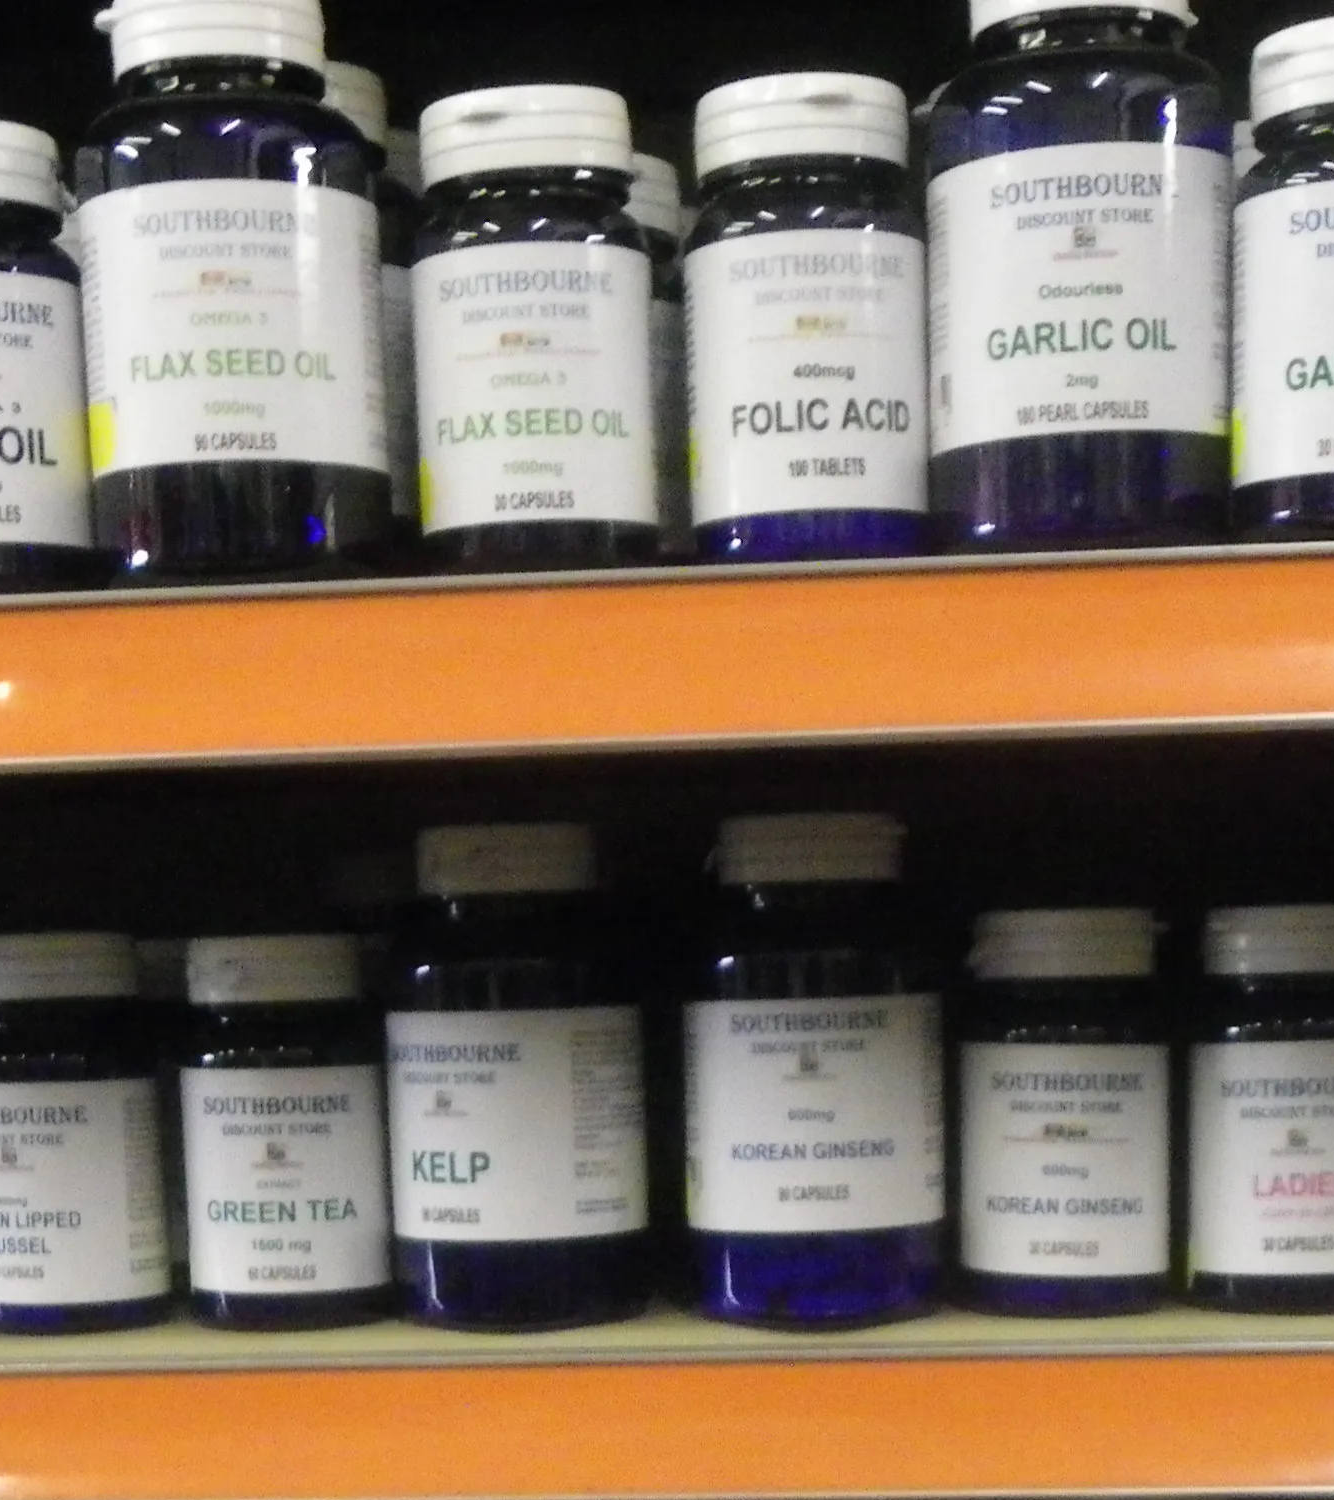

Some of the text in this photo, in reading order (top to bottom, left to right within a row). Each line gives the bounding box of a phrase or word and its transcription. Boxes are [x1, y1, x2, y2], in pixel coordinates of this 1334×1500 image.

[1037, 280, 1123, 300] Odourless
[987, 317, 1176, 362] GARLIC OIL
[130, 349, 336, 382] FLAX SEED OIL
[793, 363, 855, 383] 400mcg
[1066, 373, 1099, 389] 2mg
[731, 398, 910, 436] FOLIC ACID
[1037, 403, 1080, 423] PEARL
[436, 408, 629, 444] FLAX SEED OIL
[211, 433, 277, 451] CAPSULES
[812, 457, 866, 477] TABLETS
[509, 492, 574, 510] CAPSULES
[731, 1139, 895, 1161] KOREAN GINSENG
[413, 1151, 490, 1184] KELP
[207, 1199, 357, 1222] GREEN TEA
[987, 1197, 1144, 1215] KOREAN GINSENG
[16, 1211, 81, 1228] LIPPED
